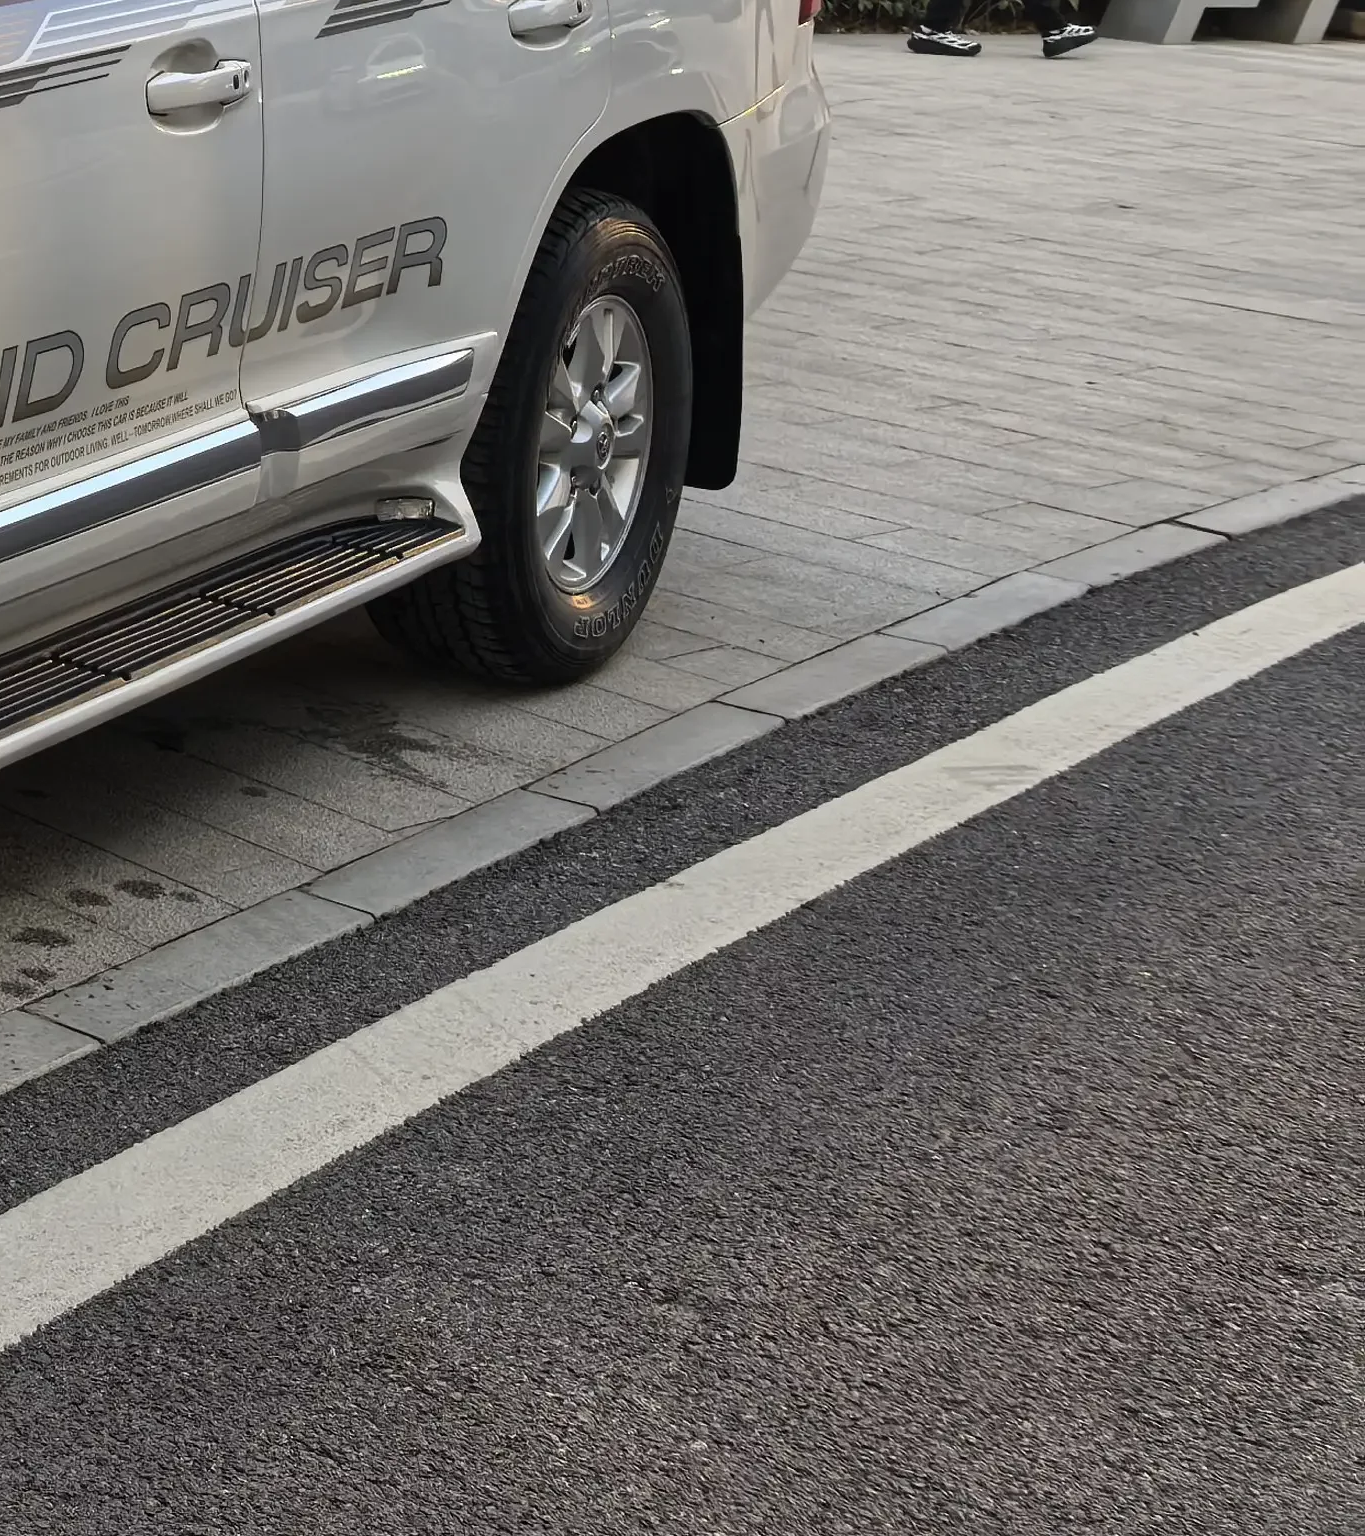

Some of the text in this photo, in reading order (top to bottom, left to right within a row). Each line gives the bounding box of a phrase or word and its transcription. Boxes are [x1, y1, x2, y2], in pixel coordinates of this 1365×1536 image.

[105, 216, 448, 390] CRUISER
[0, 453, 15, 467] THE
[15, 444, 45, 461] REASON
[46, 437, 62, 452] WHY
[68, 427, 97, 443] CHOOSE
[97, 419, 113, 434] THIS
[113, 412, 129, 427] CAR
[128, 409, 136, 421] IS
[135, 397, 167, 420] BECAUSE
[173, 389, 188, 405] WILL
[14, 428, 41, 445] FAMILY
[40, 421, 57, 436] AND
[95, 401, 114, 417] LOVE
[34, 458, 50, 474] FOR
[50, 445, 85, 467] OUTDOOR
[194, 398, 213, 414] SHALL
[214, 394, 225, 407] WE
[225, 388, 238, 404] GO?
[574, 520, 664, 640] DUNLOP
